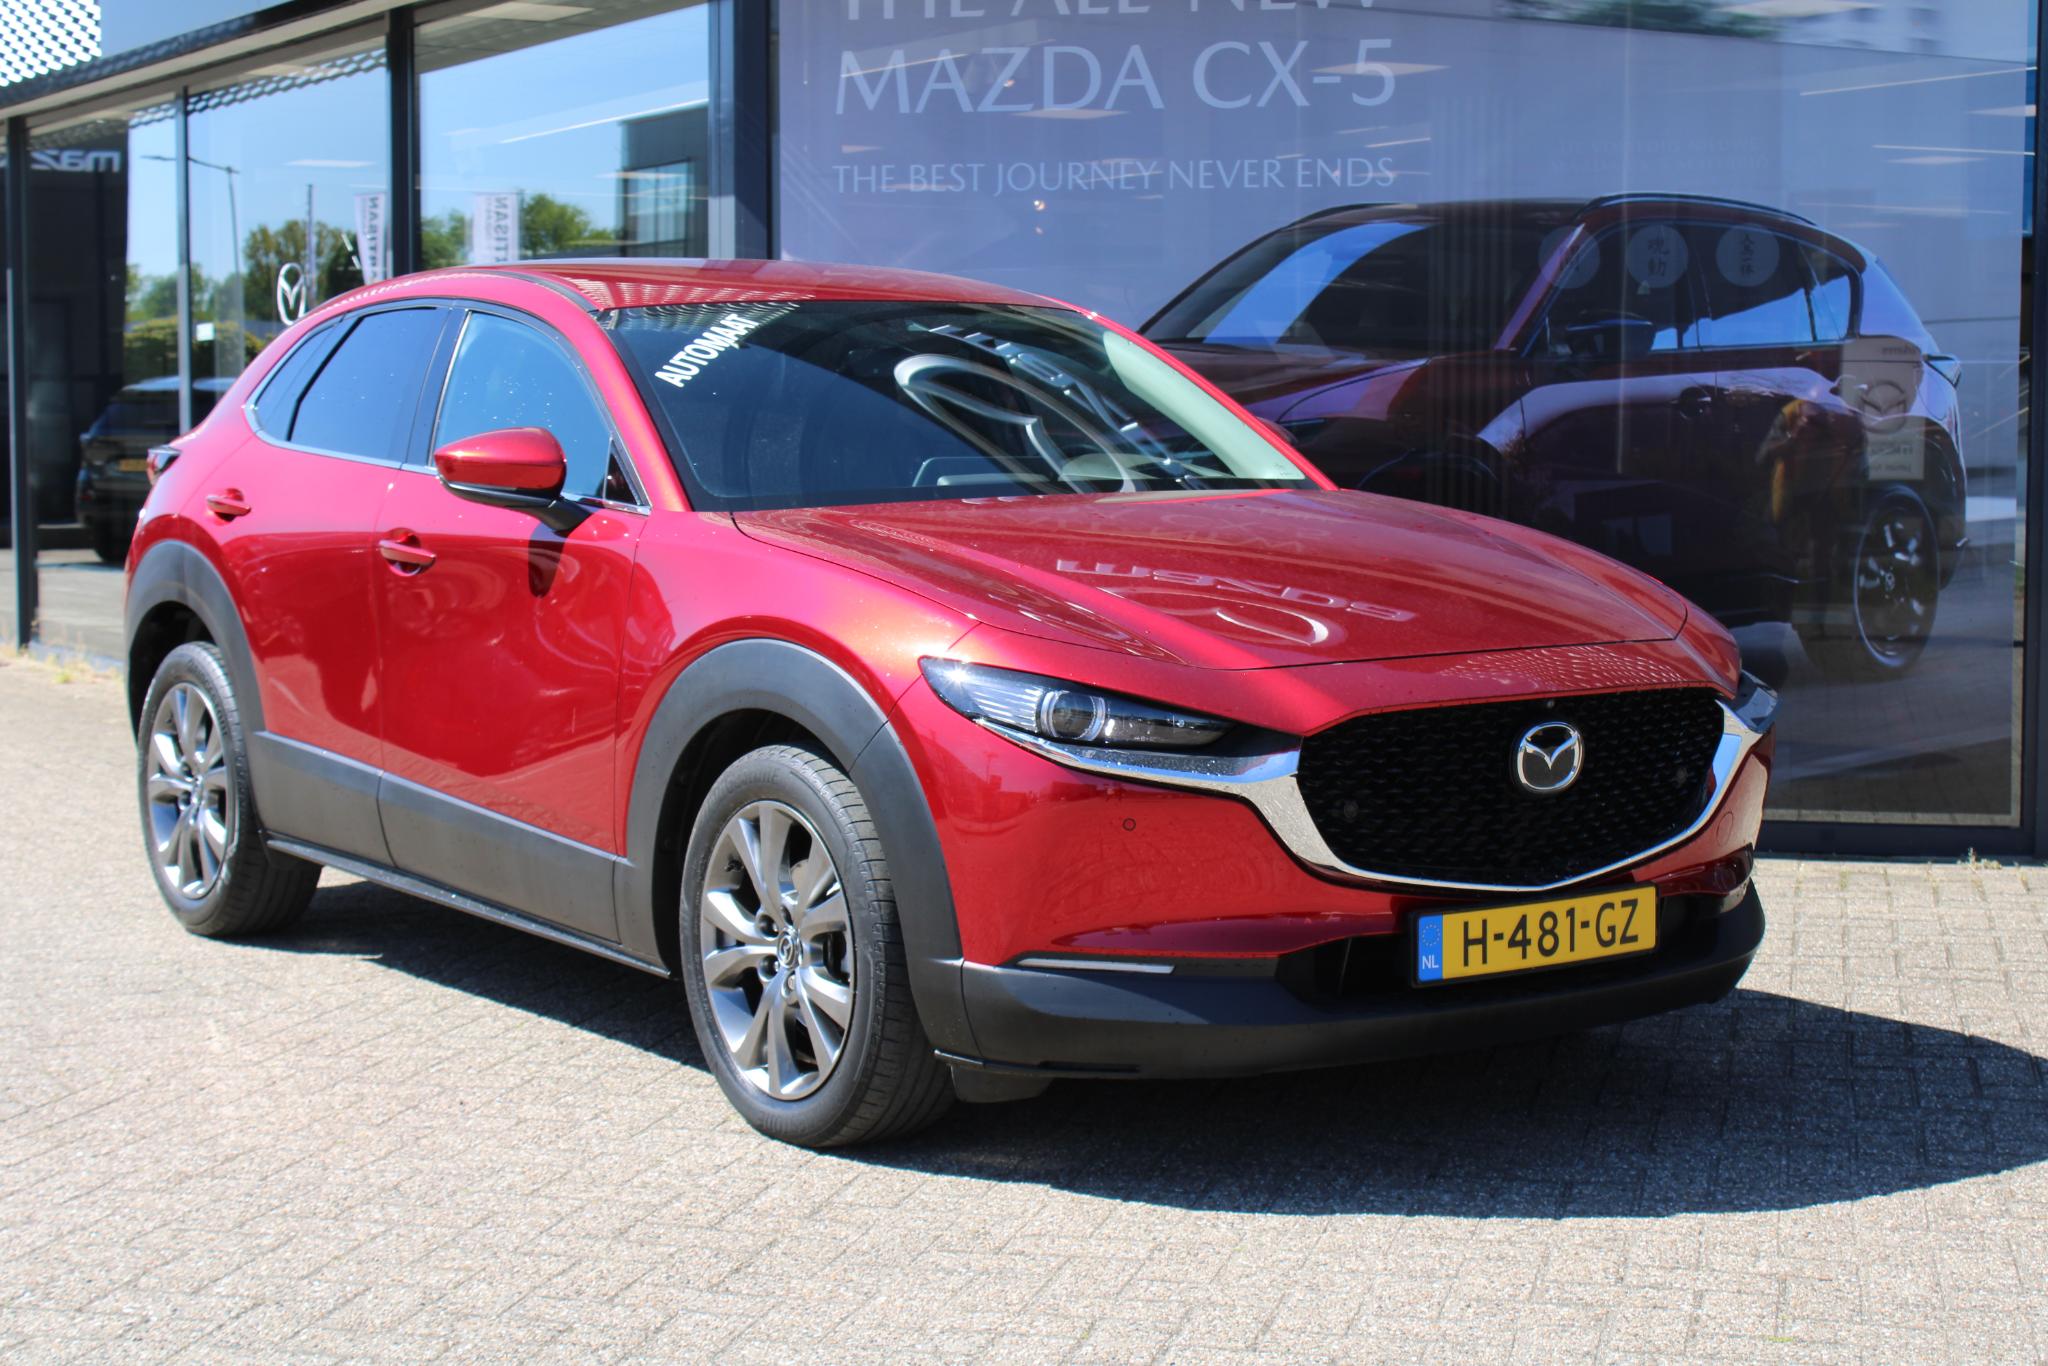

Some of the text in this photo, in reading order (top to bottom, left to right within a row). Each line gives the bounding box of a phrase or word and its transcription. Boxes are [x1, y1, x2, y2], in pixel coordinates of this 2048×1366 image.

[836, 38, 1395, 114] MAZDA CX-5
[832, 157, 1395, 197] THE BEST JOURNEY NEVER ENDS
[654, 313, 760, 388] AUTOMAAT
[1422, 955, 1439, 970] NL
[1463, 898, 1639, 967] H-481-GZ
